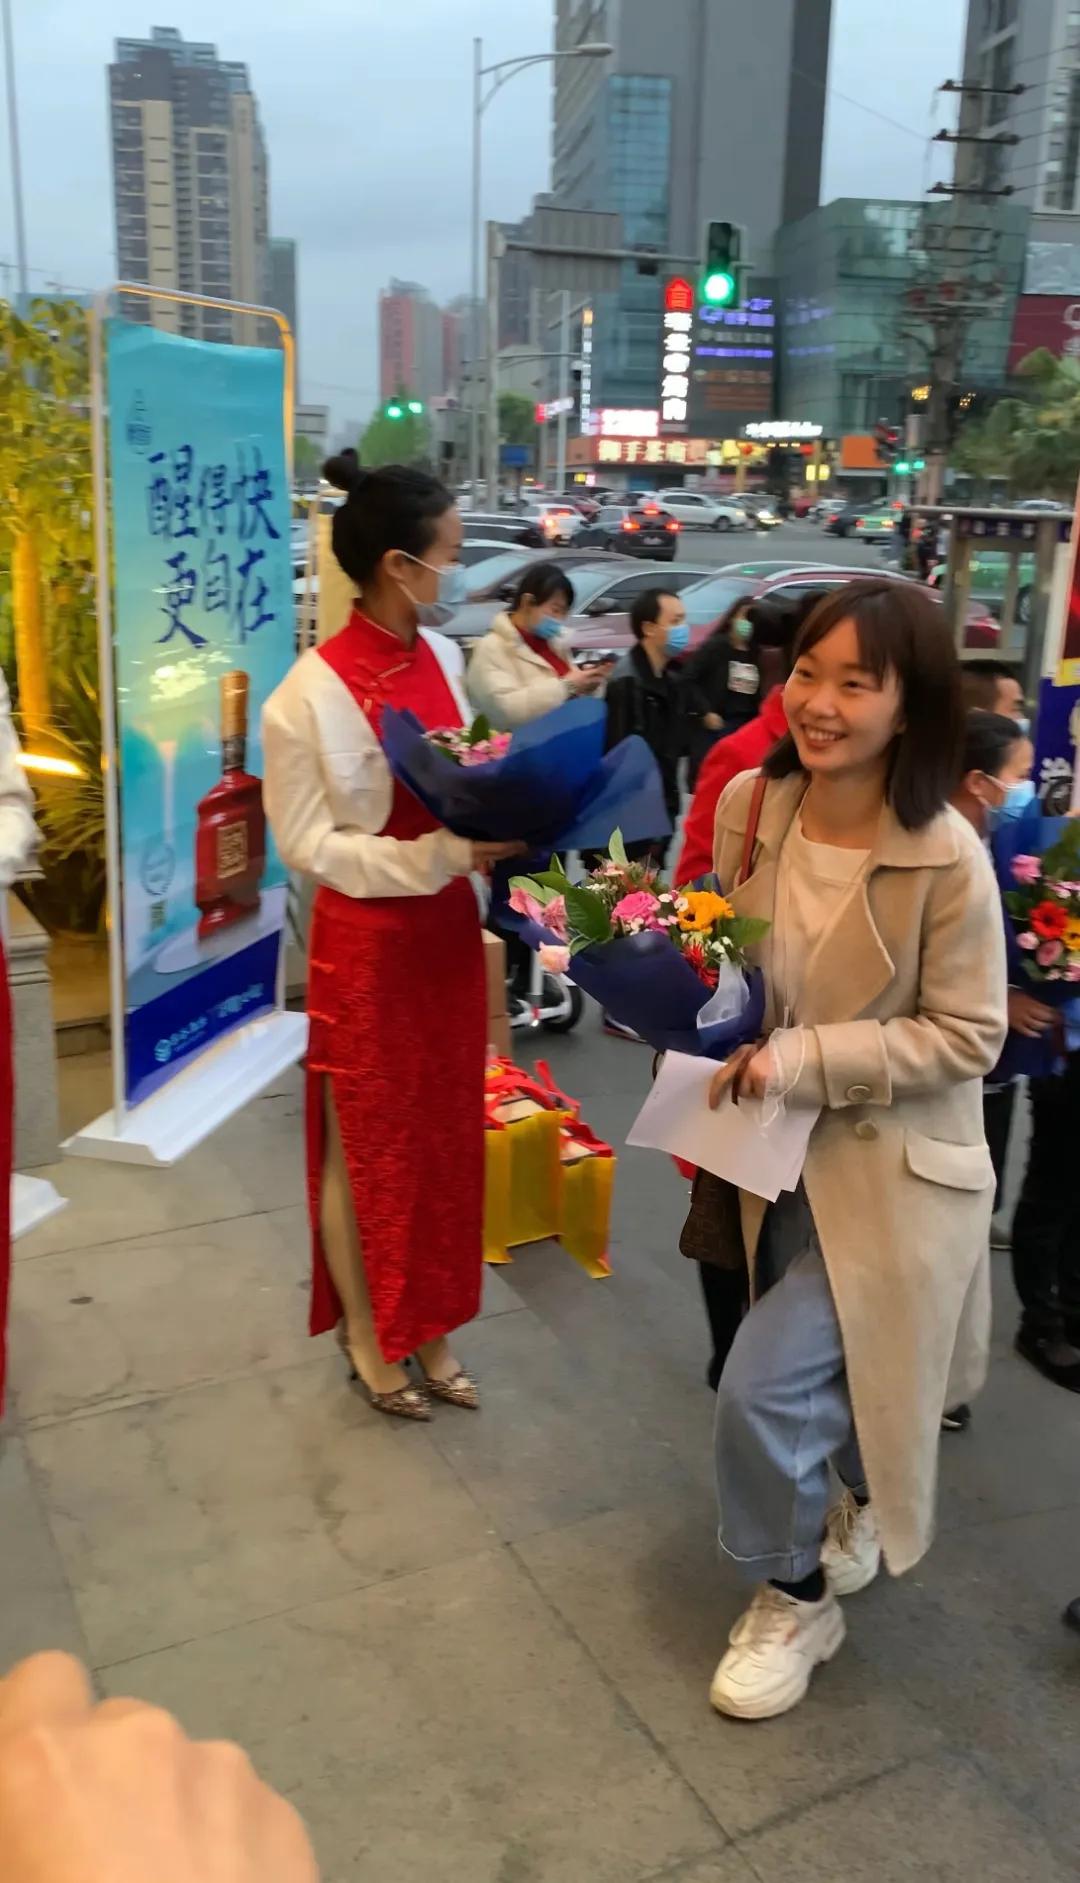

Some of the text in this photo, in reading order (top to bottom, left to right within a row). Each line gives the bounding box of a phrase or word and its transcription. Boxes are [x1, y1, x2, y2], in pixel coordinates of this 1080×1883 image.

[147, 443, 281, 542] 醒得快
[154, 540, 276, 648] 更自在
